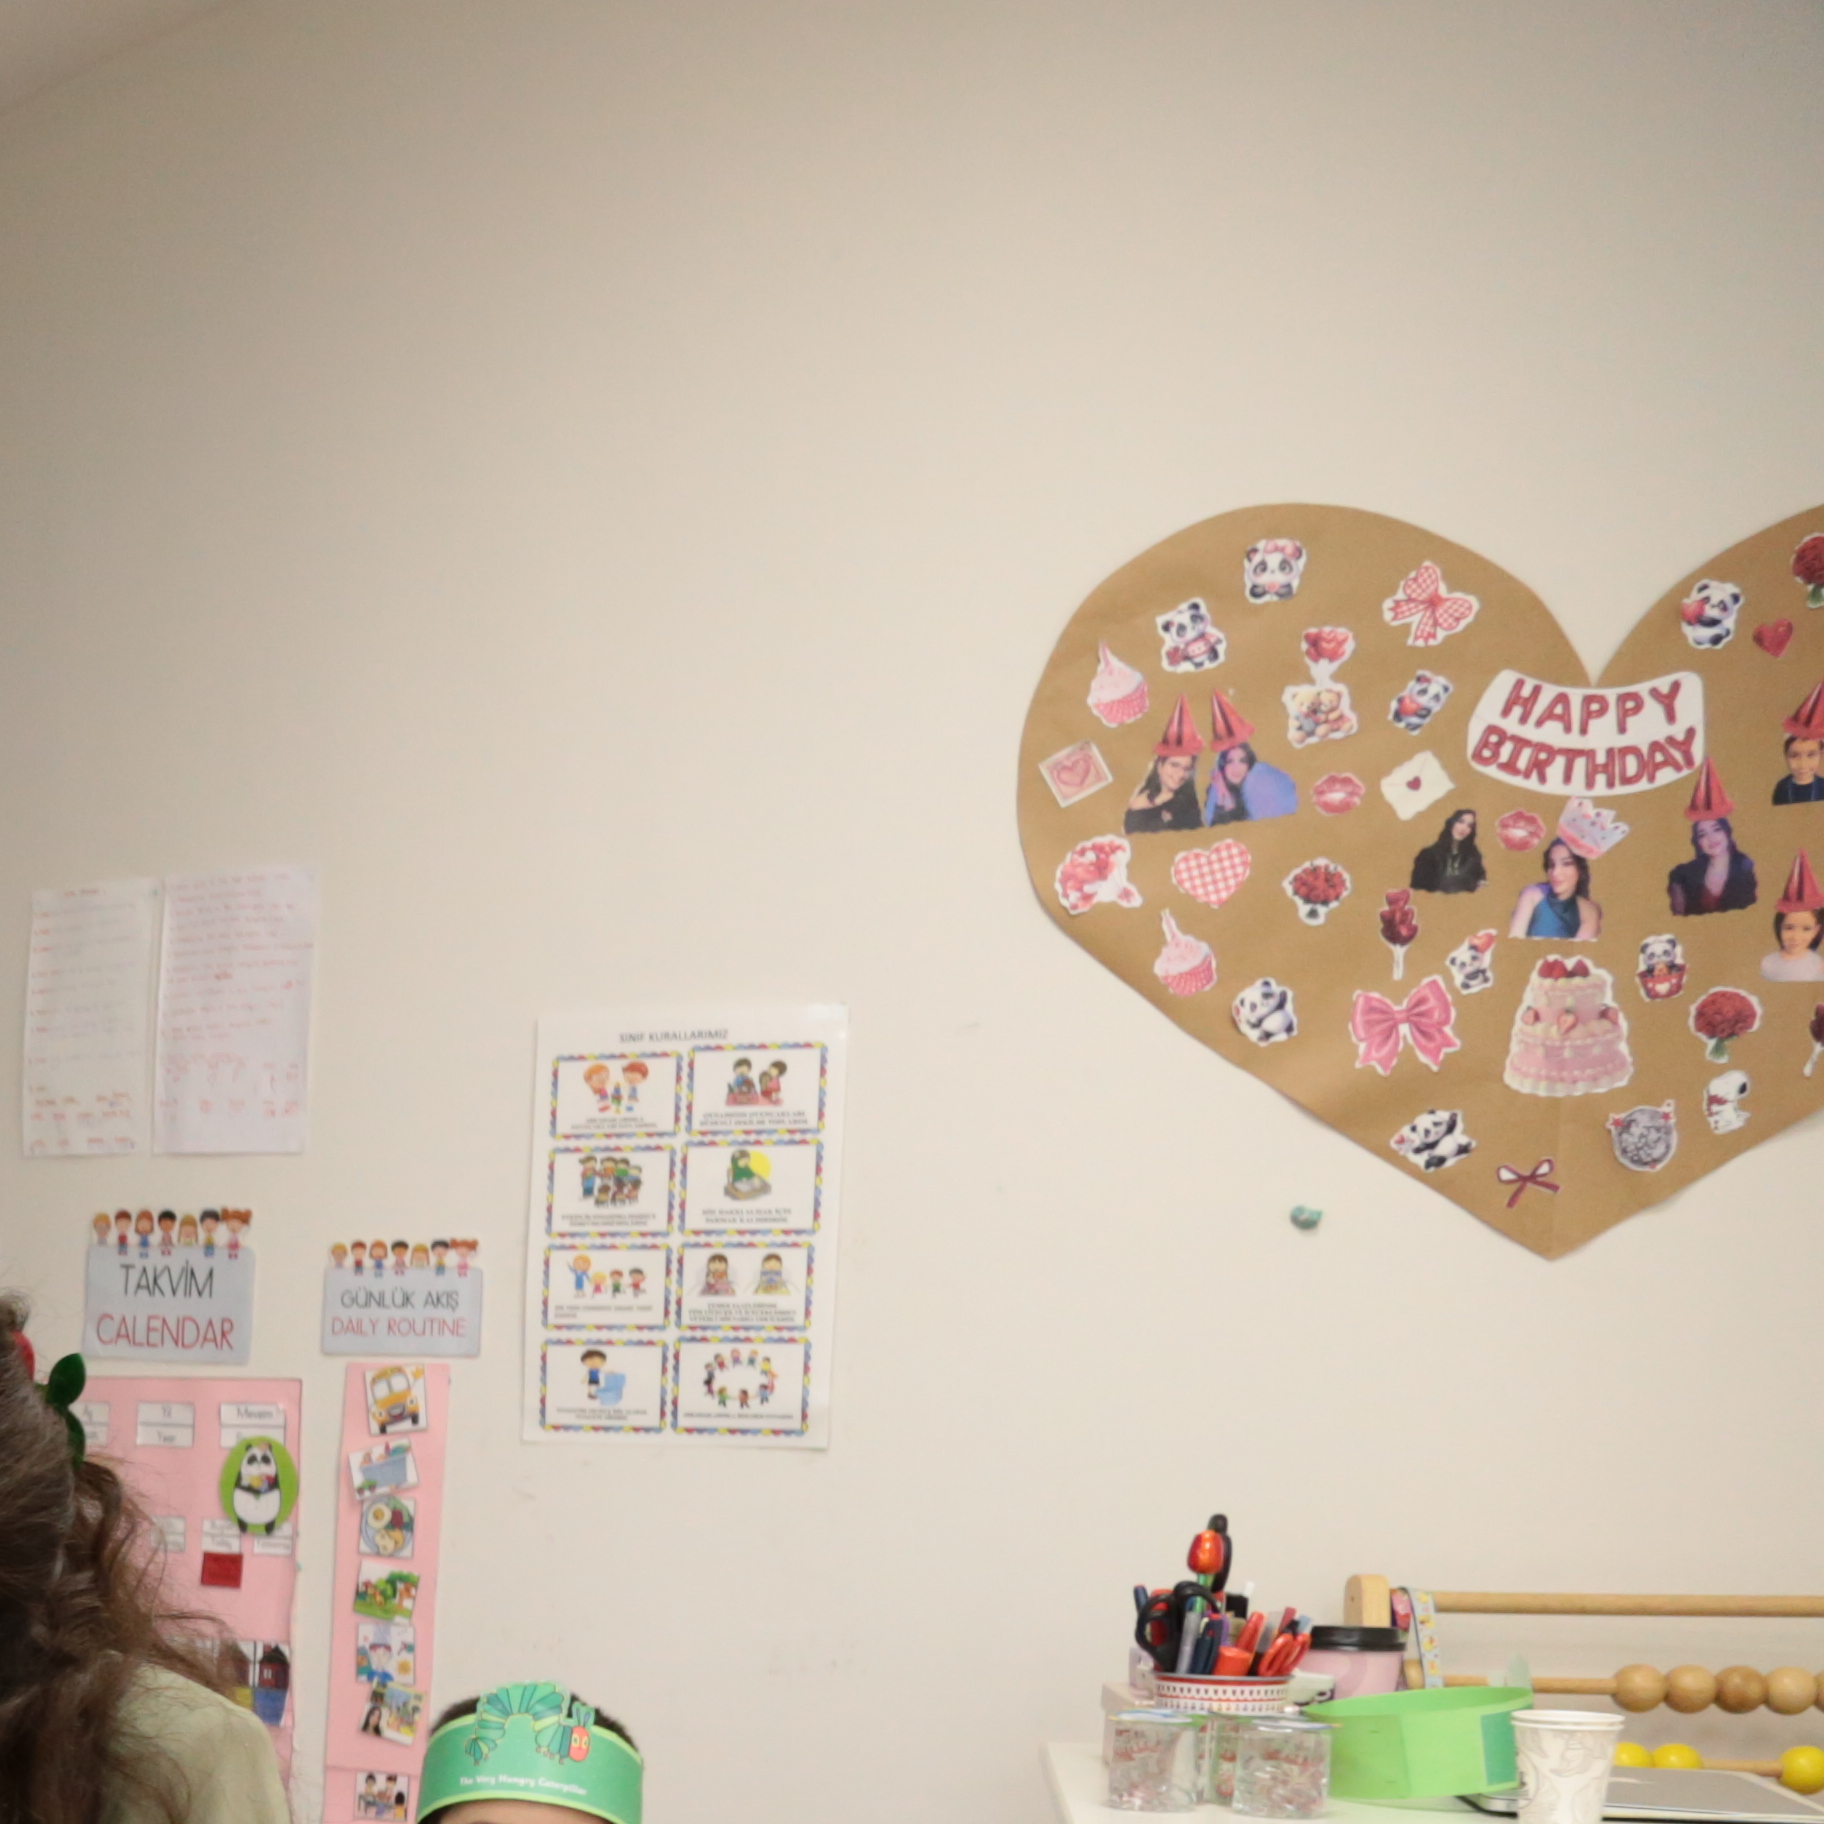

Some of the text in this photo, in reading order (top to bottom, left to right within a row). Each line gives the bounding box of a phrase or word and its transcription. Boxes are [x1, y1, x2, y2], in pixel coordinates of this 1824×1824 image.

[1499, 676, 1683, 737] HAPPY
[1469, 723, 1701, 791] BIRTHDAY
[119, 1259, 215, 1300] TAKVİM
[340, 1286, 460, 1315] GÜNLÜK AKIŞ
[96, 1315, 234, 1352] CALENDAR
[331, 1316, 468, 1340] DAILY ROUTINE
[499, 1774, 535, 1788] Hungry
[538, 1777, 588, 1796] Caterpillar
